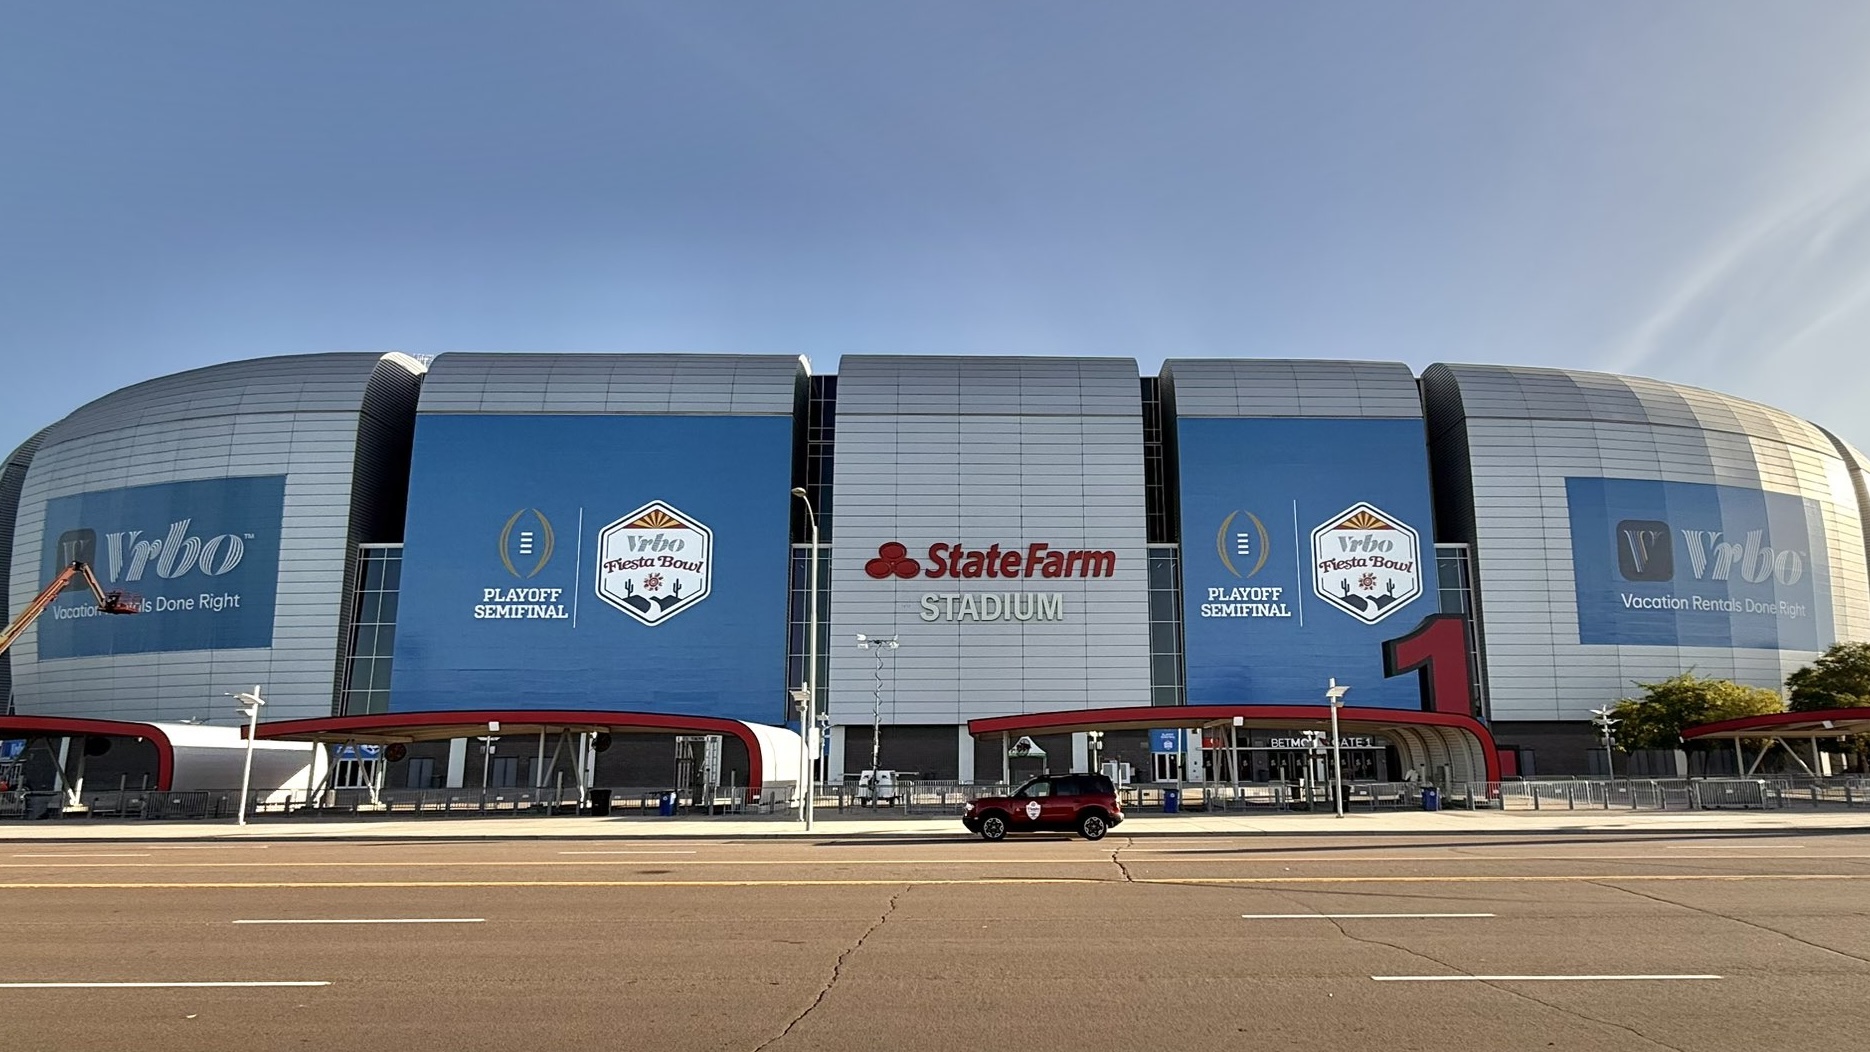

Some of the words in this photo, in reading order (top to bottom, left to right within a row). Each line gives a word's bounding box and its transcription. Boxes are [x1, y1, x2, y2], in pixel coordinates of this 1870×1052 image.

[627, 533, 686, 553] Vrbo
[1338, 533, 1394, 553] Vrbo
[603, 556, 656, 574] Fiesta
[657, 555, 705, 574] Bowl
[1319, 556, 1368, 574] Fiesta
[1368, 555, 1414, 574] Bowl
[156, 596, 194, 612] Done
[199, 592, 241, 612] Right
[483, 588, 562, 603] PLAYOFF
[1208, 587, 1283, 601] PLAYOFF
[474, 604, 569, 619] SEMIFINAL
[919, 592, 1064, 623] STADIUM
[1201, 603, 1292, 618] SEMIFINAL
[1621, 593, 1689, 611] Vacation
[1692, 595, 1742, 613] Rentals
[1745, 598, 1777, 615] Done
[1779, 601, 1806, 619] Right
[1382, 613, 1477, 716] 1
